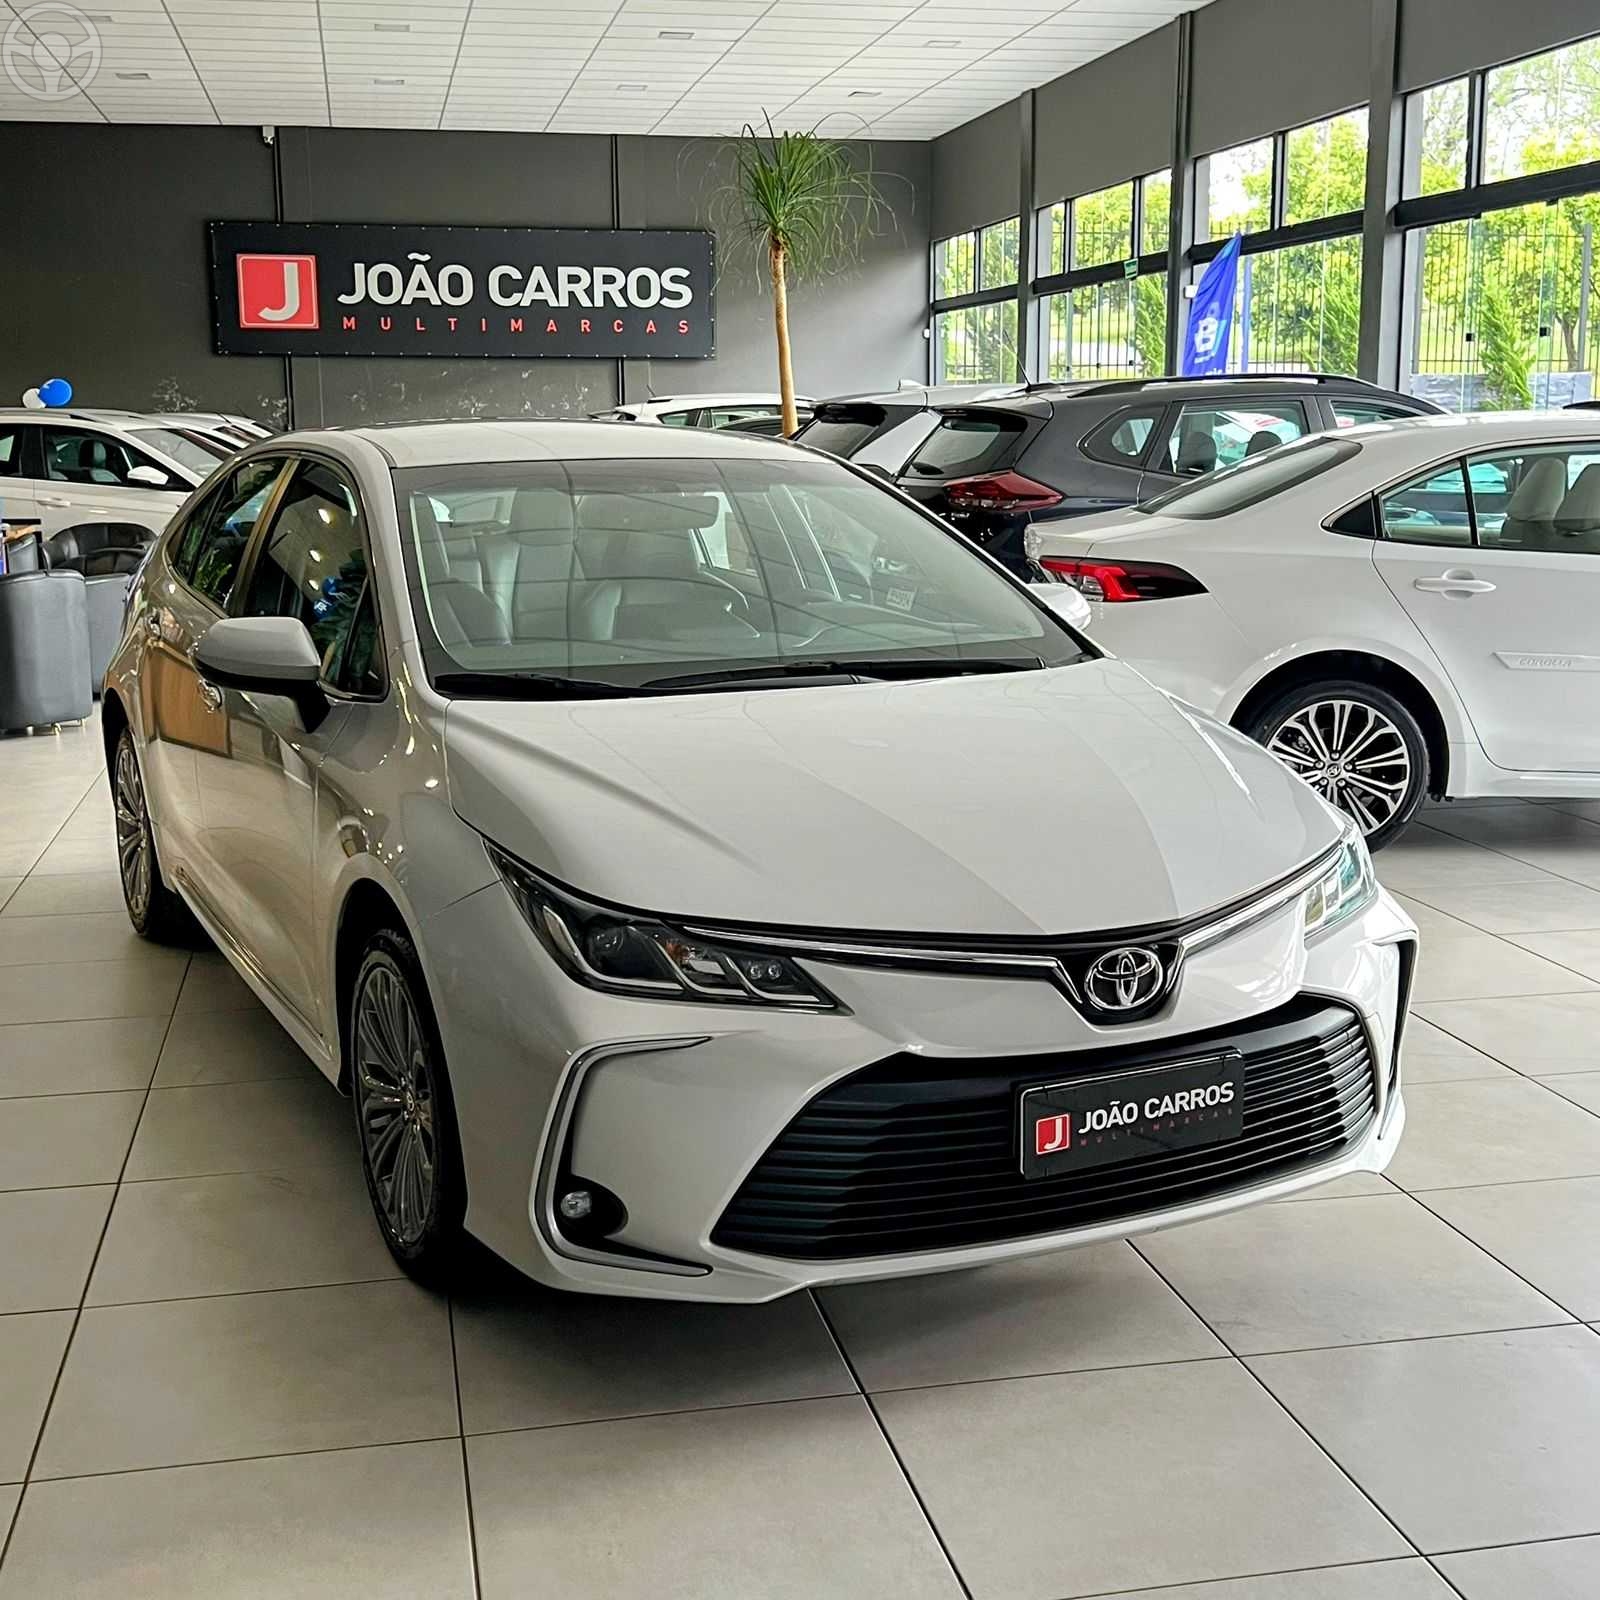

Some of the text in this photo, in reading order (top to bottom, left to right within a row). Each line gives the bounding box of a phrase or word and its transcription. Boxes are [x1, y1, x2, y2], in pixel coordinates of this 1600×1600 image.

[257, 261, 300, 322] J
[337, 252, 693, 309] JOÃO CARROS
[342, 316, 690, 334] MULTIMARCAS
[1043, 1117, 1063, 1150] J
[1078, 1082, 1234, 1134] JOÃO CARROS
